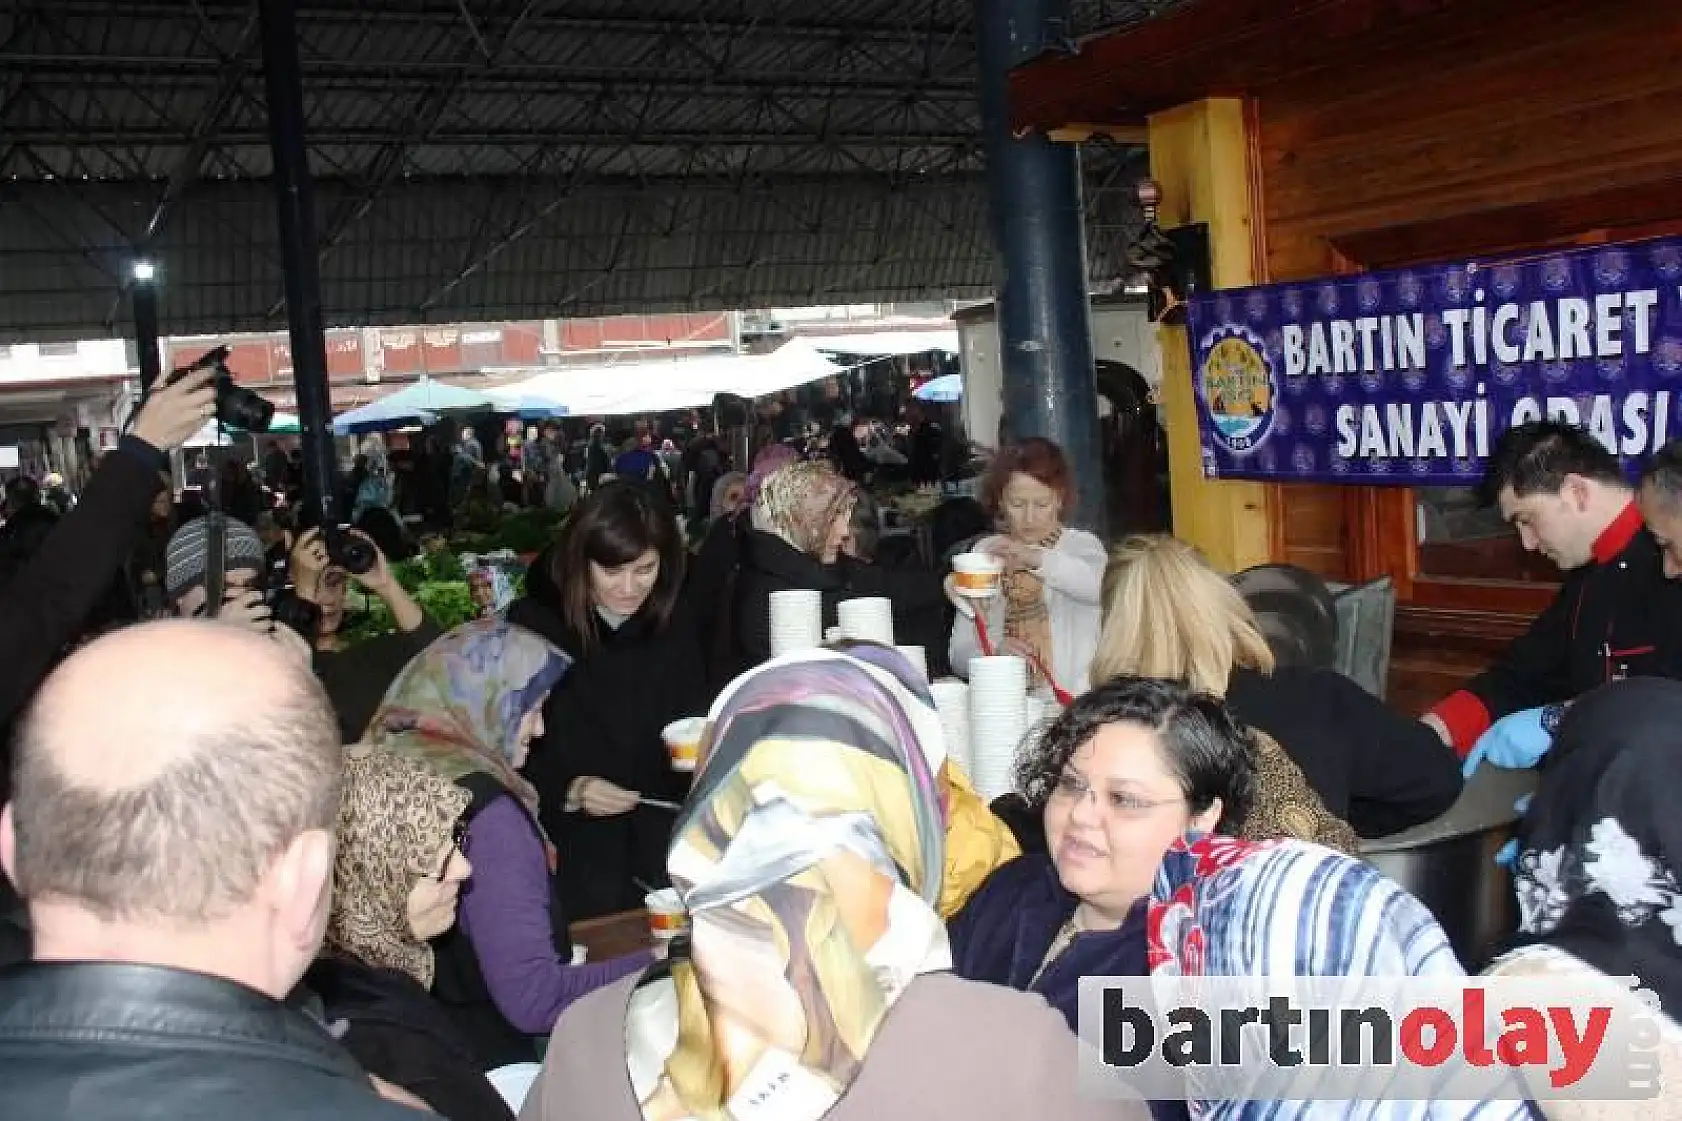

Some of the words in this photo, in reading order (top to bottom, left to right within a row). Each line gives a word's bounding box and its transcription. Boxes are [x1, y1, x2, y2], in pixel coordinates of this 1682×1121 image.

[1282, 313, 1426, 375] BARTIN
[1442, 288, 1658, 365] TİCARET
[1336, 382, 1489, 457] SANAYİ
